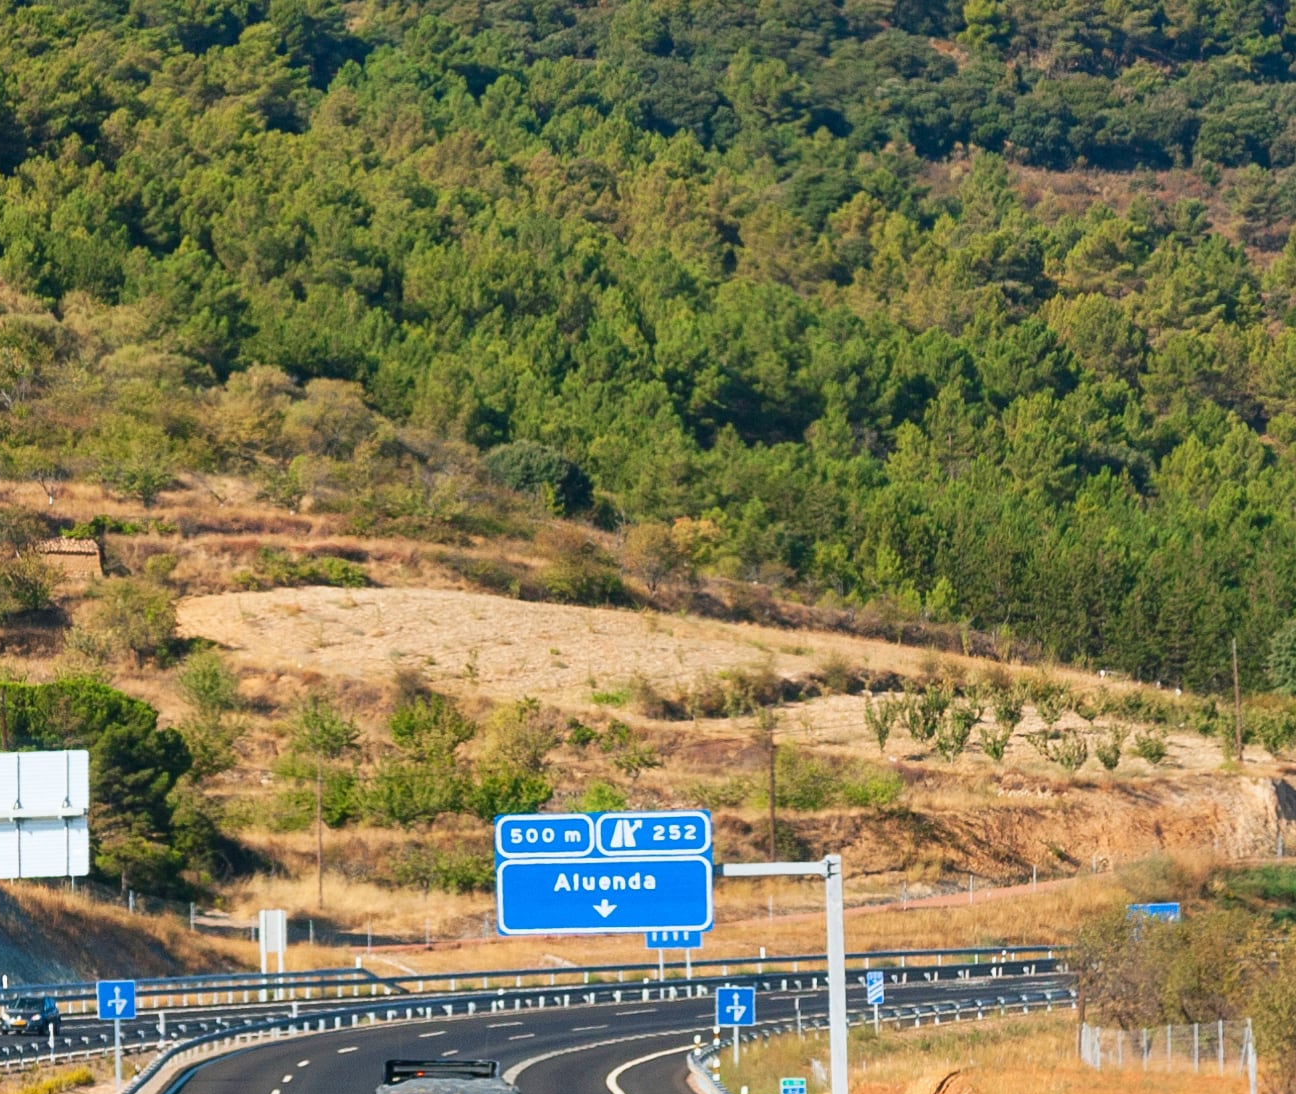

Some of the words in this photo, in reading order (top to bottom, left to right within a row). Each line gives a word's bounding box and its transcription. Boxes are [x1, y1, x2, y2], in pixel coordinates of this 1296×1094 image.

[510, 827, 555, 844] 500
[564, 829, 581, 843] m
[652, 824, 697, 841] 252
[554, 872, 656, 892] Aluenda
